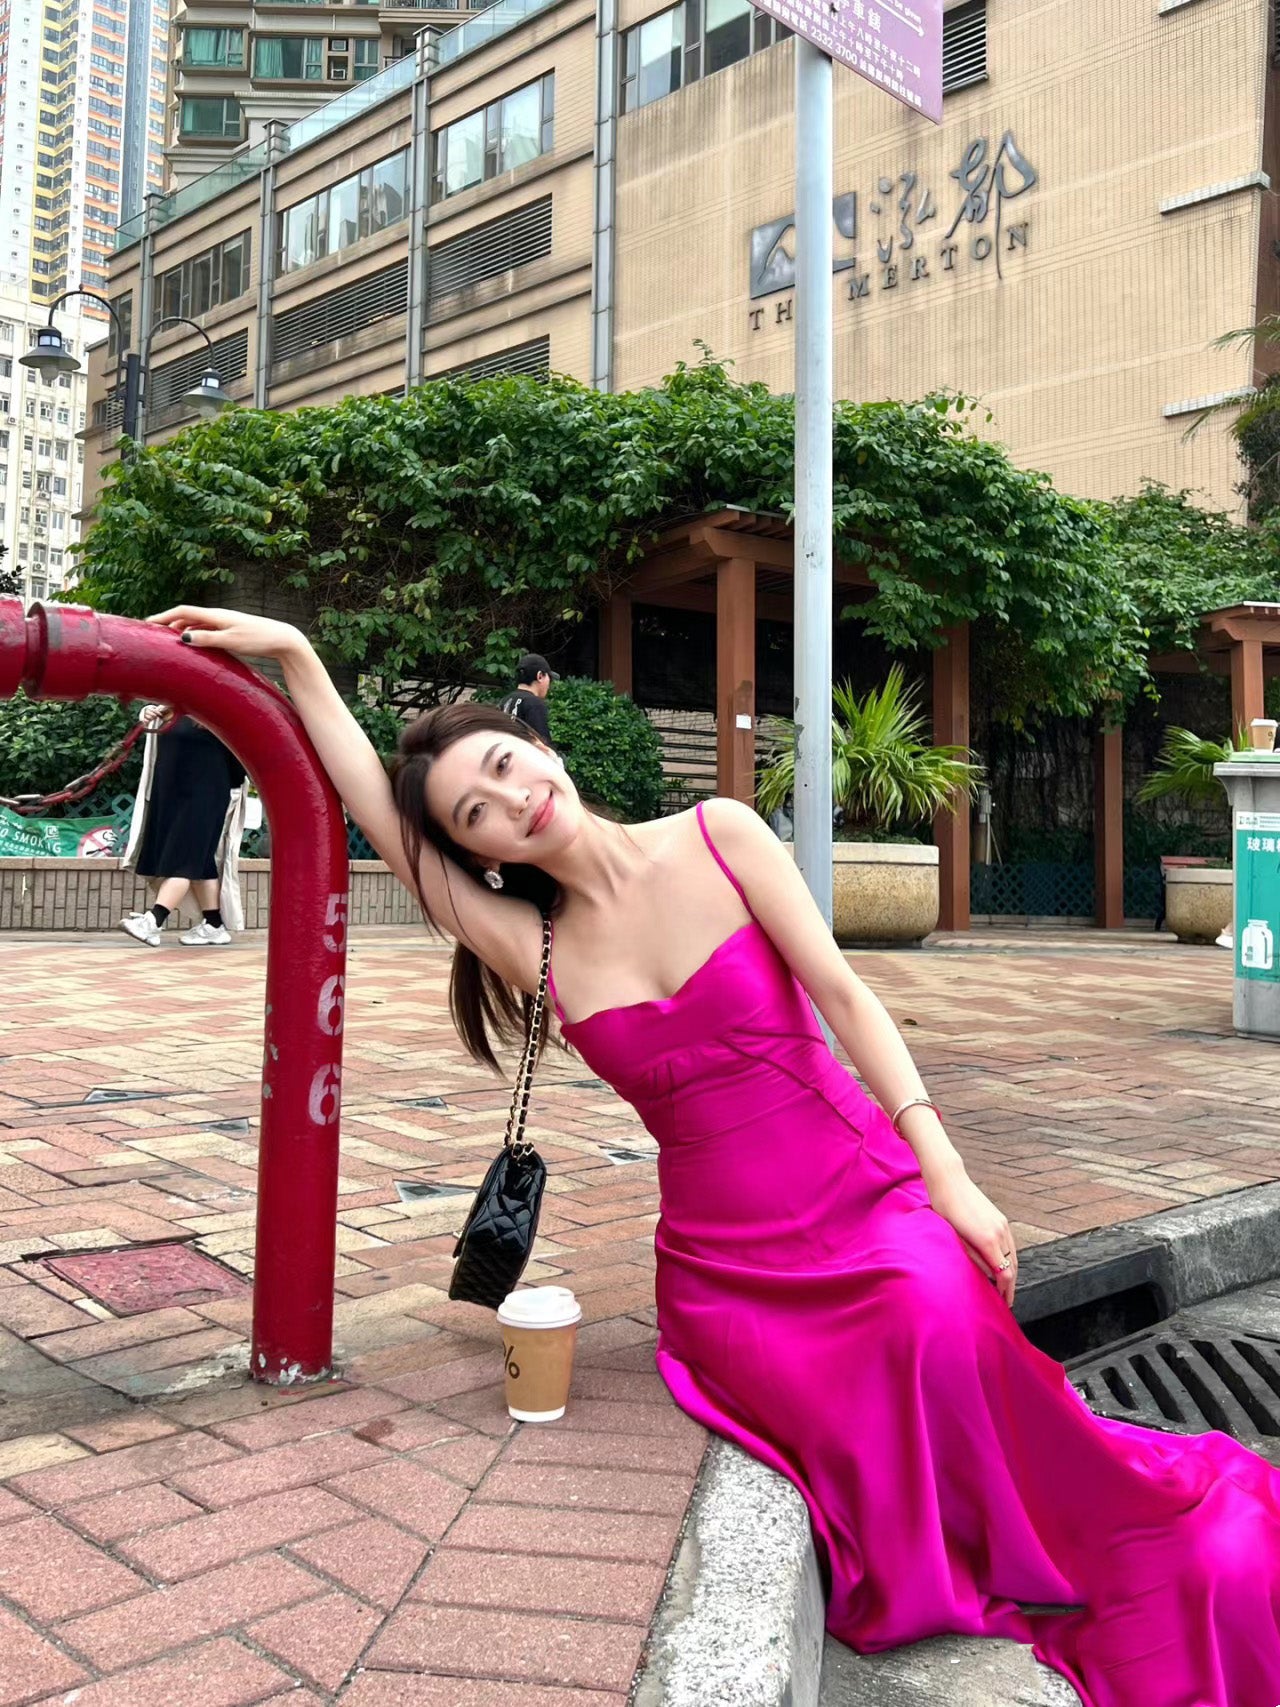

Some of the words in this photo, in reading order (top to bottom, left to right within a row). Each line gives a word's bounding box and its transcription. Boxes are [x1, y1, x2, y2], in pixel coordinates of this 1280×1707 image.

[811, 26, 833, 49] 2332
[835, 42, 858, 66] 3700
[749, 299, 793, 331] TH
[847, 222, 1030, 302] MERTON
[308, 892, 348, 1126] 566
